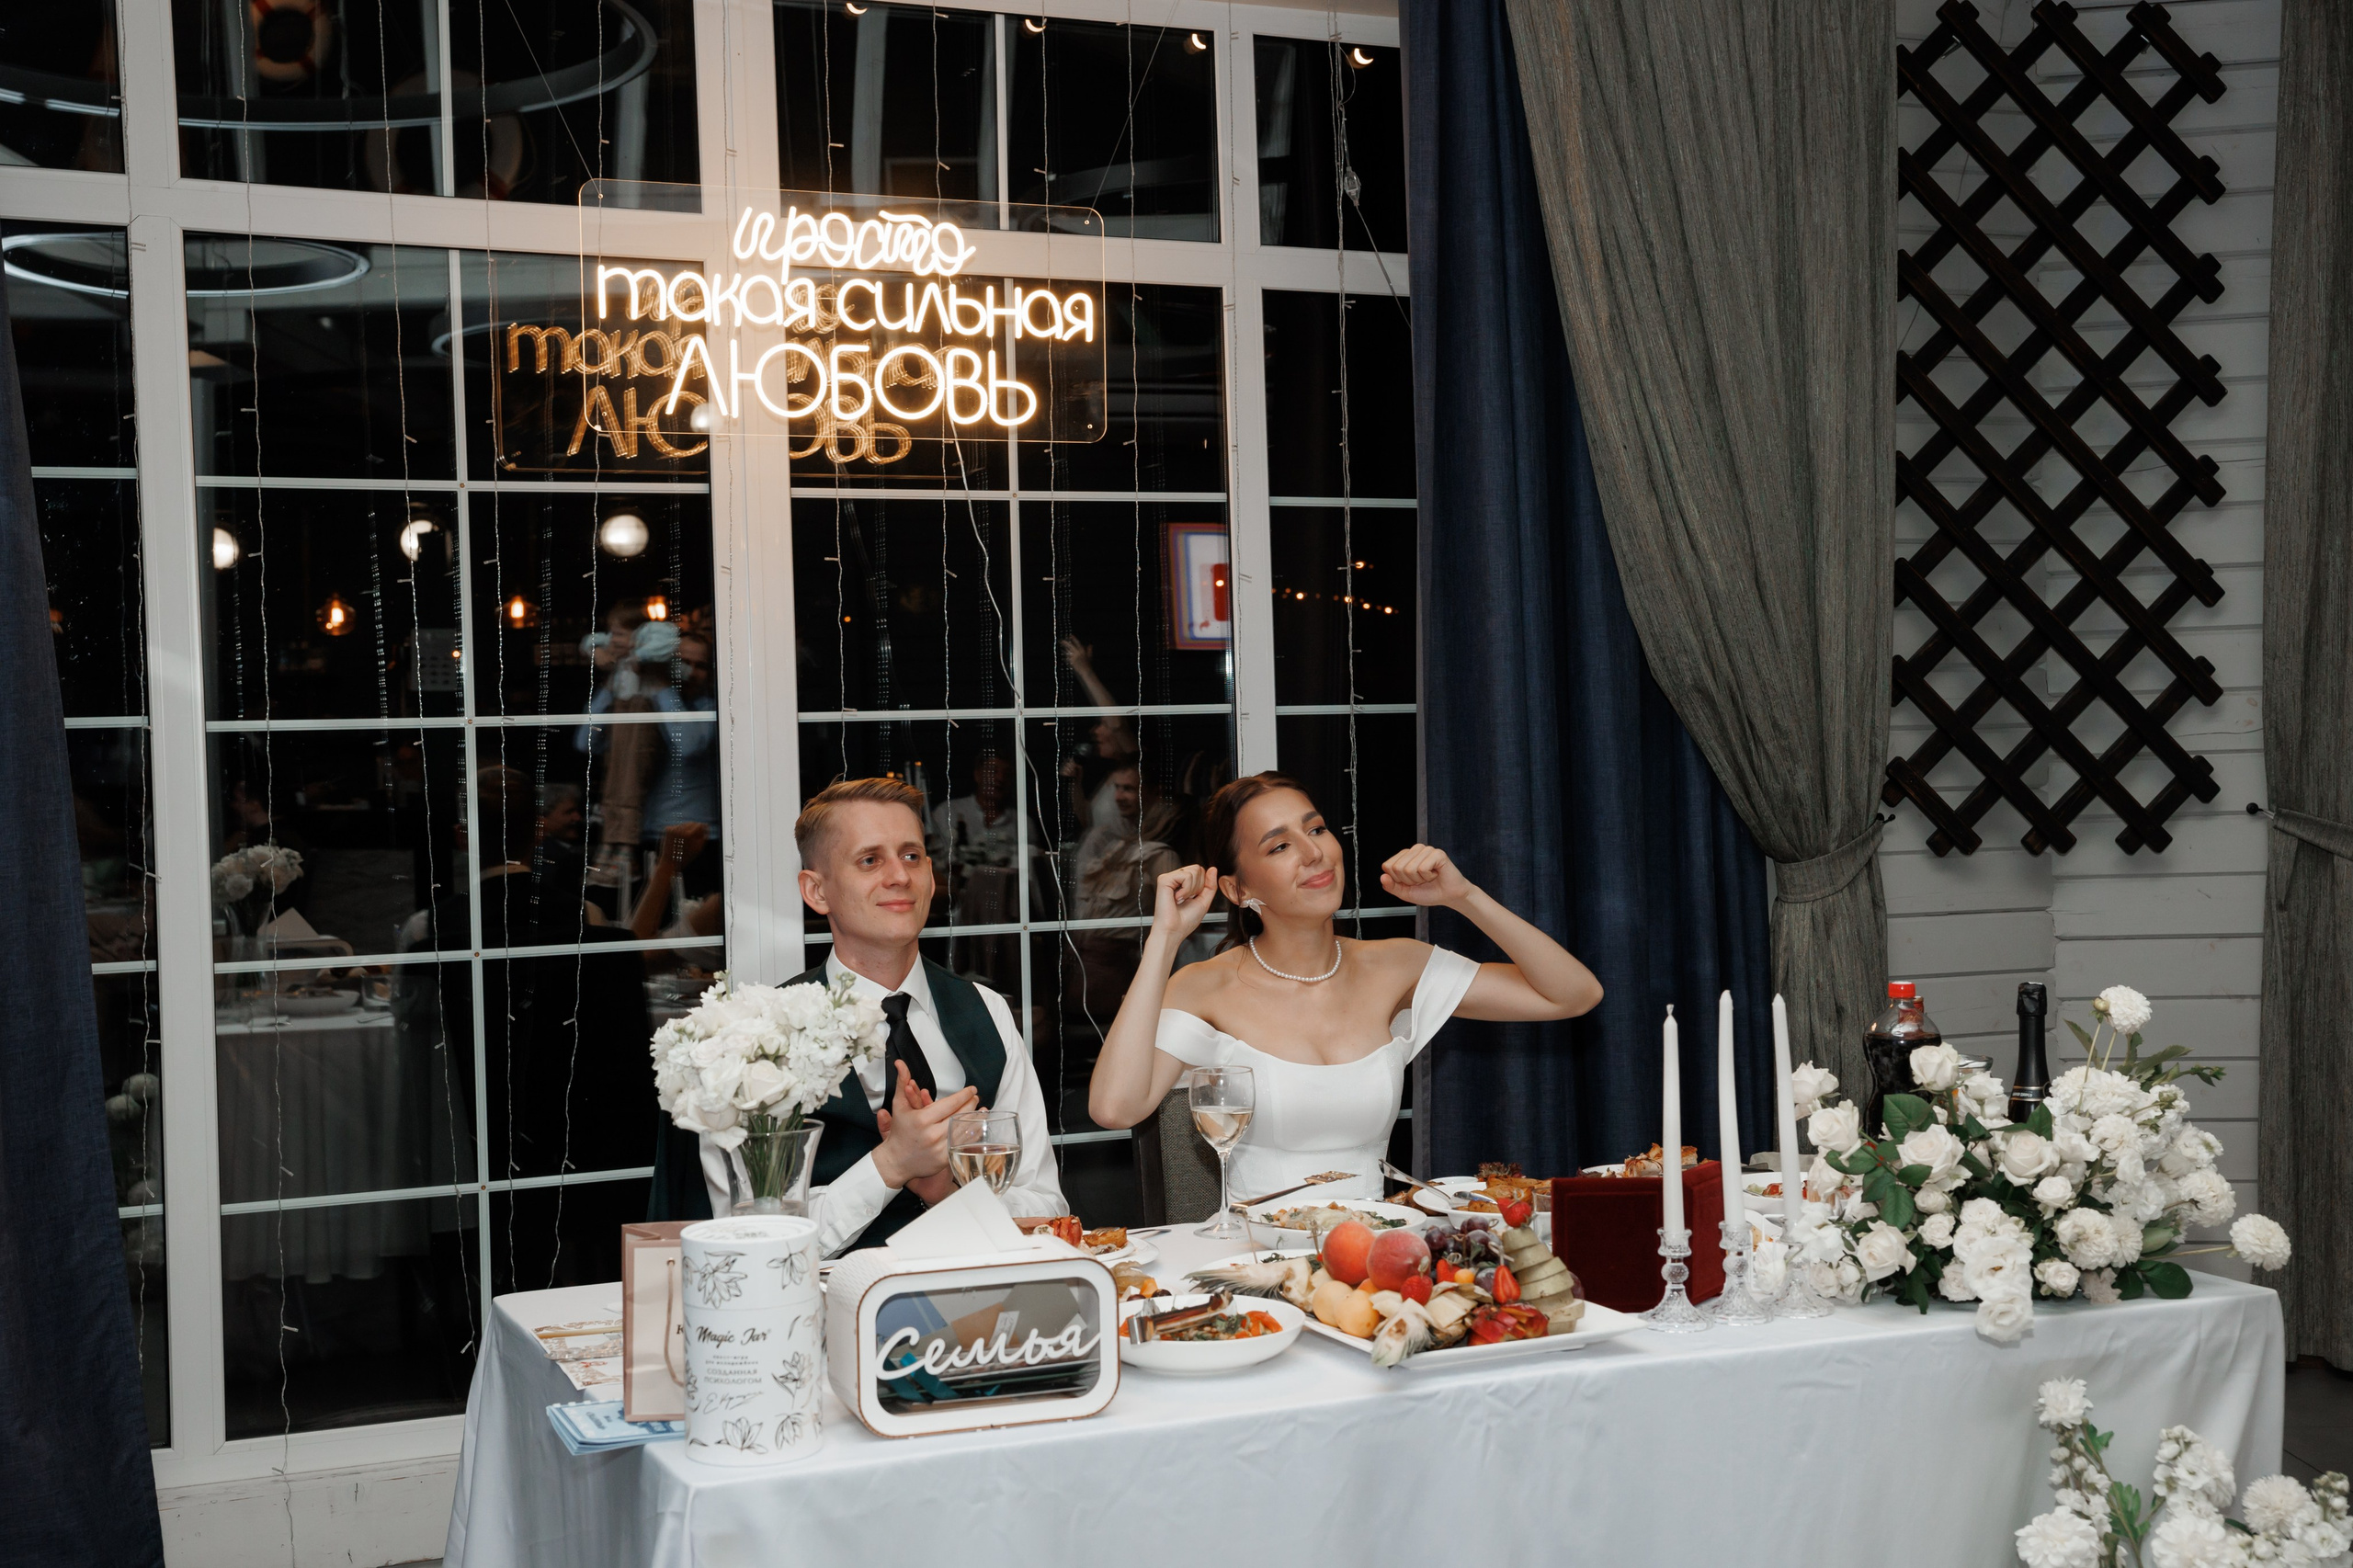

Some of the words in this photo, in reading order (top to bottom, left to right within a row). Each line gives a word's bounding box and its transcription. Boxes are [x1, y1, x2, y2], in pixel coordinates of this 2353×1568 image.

[733, 206, 976, 285] просто
[597, 264, 815, 328] такая
[837, 278, 1095, 343] сильная
[665, 335, 1038, 427] ЛЮБОВЬ
[695, 1325, 735, 1348] Magic
[876, 1324, 1101, 1381] Семья
[704, 1376, 762, 1384] ПСИХОЛОГОМ
